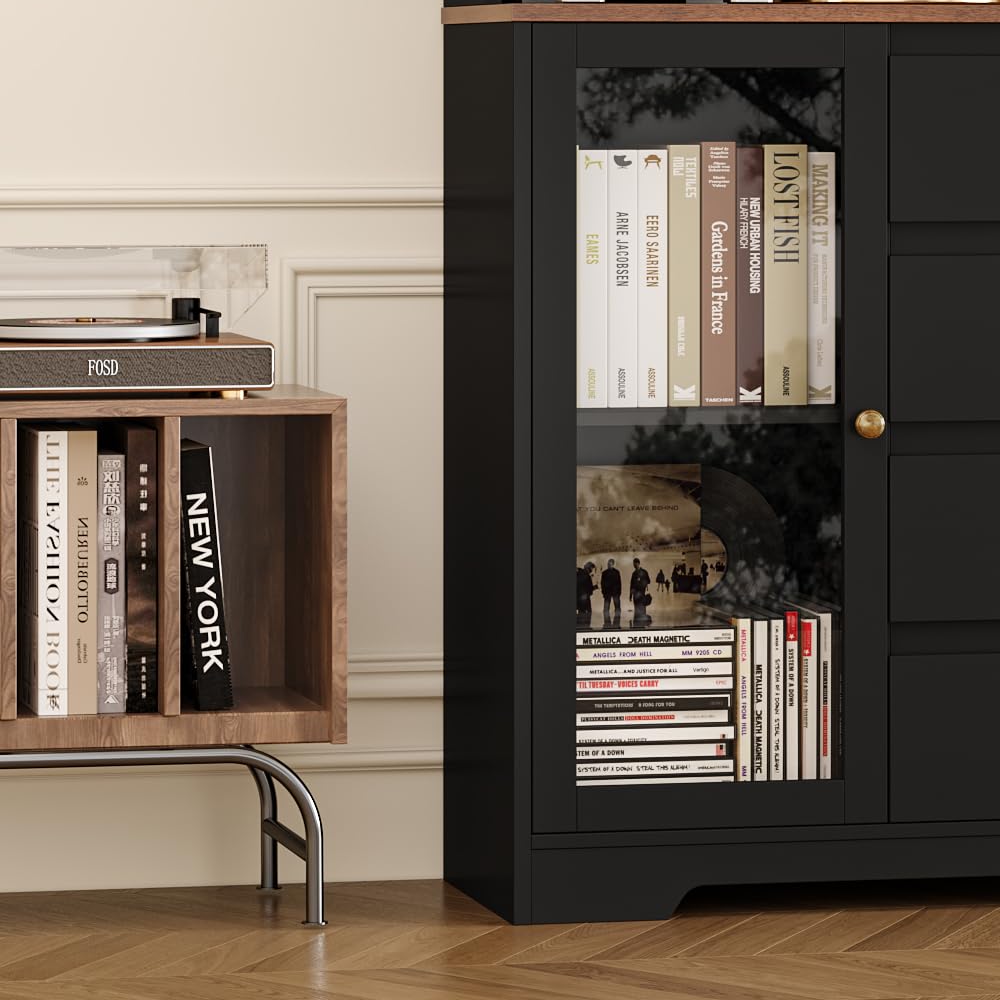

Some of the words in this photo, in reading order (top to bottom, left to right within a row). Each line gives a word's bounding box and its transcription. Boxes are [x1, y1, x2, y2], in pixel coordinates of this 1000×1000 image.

[773, 151, 800, 209] LOST
[812, 164, 829, 226] MAKING
[616, 211, 629, 236] ARNE
[740, 197, 748, 221] HILARY
[750, 197, 761, 219] NEW
[646, 215, 659, 238] EERO
[740, 221, 748, 249] FRENCH
[750, 220, 761, 251] URBAN
[773, 215, 800, 264] FISH
[812, 231, 829, 247] IT
[586, 234, 599, 265] EAMES
[616, 239, 629, 287] JACOBSEN
[711, 221, 729, 274] Gardens
[646, 241, 659, 287] SAARINEN
[750, 253, 761, 294] HOUSING
[711, 276, 729, 288] in
[711, 291, 729, 335] France
[88, 359, 119, 376] FOSD
[618, 368, 626, 399] ASSOULINE
[647, 368, 656, 399] ASSOULINE
[186, 492, 214, 569] NEW
[195, 576, 224, 673] YORK
[582, 636, 621, 645] METALLICA
[653, 635, 690, 643] MAGNETIC
[755, 664, 763, 704] METALLICA
[755, 736, 763, 774] MAGNETIC
